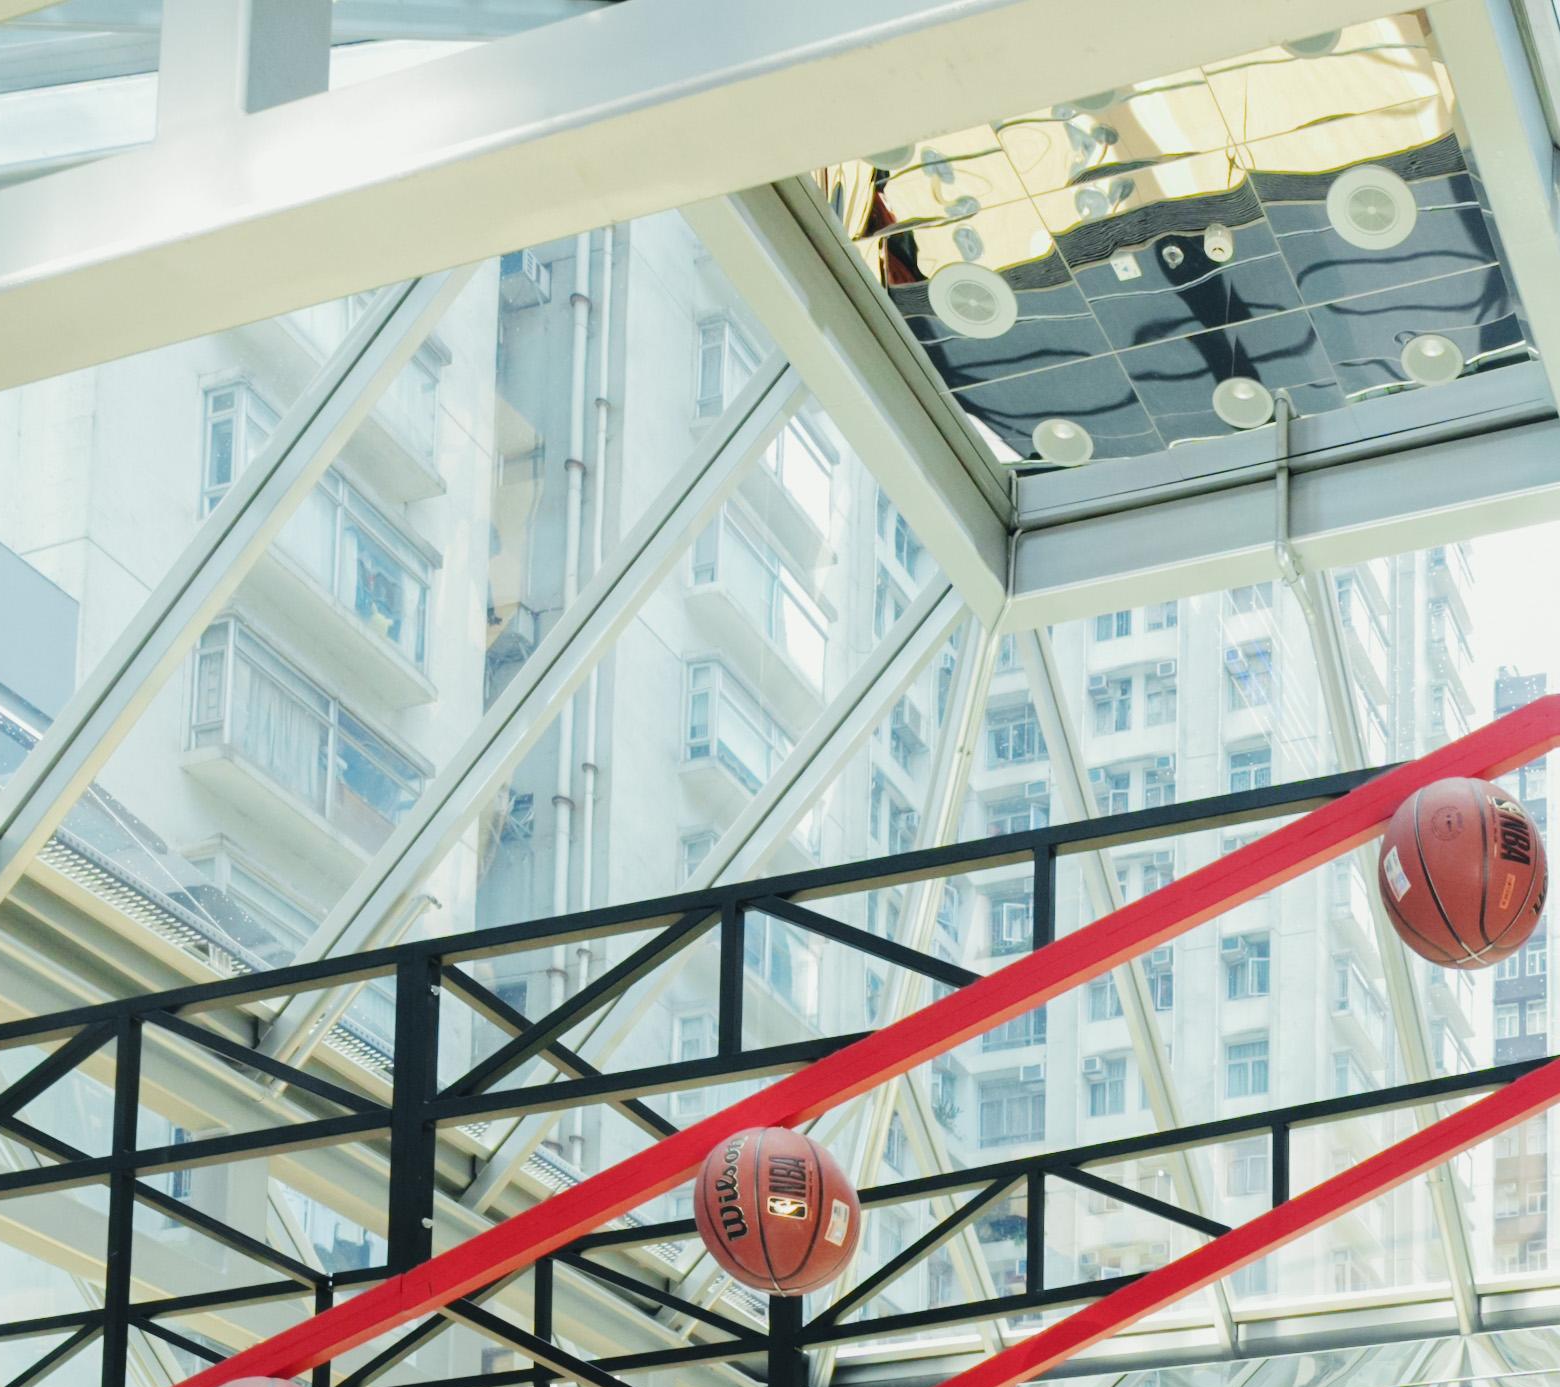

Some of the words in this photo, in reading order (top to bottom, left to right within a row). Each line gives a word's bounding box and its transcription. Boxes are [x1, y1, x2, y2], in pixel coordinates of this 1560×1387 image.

[1499, 813, 1532, 866] NBA
[715, 1136, 750, 1242] Wilson
[768, 1155, 807, 1199] NBA
